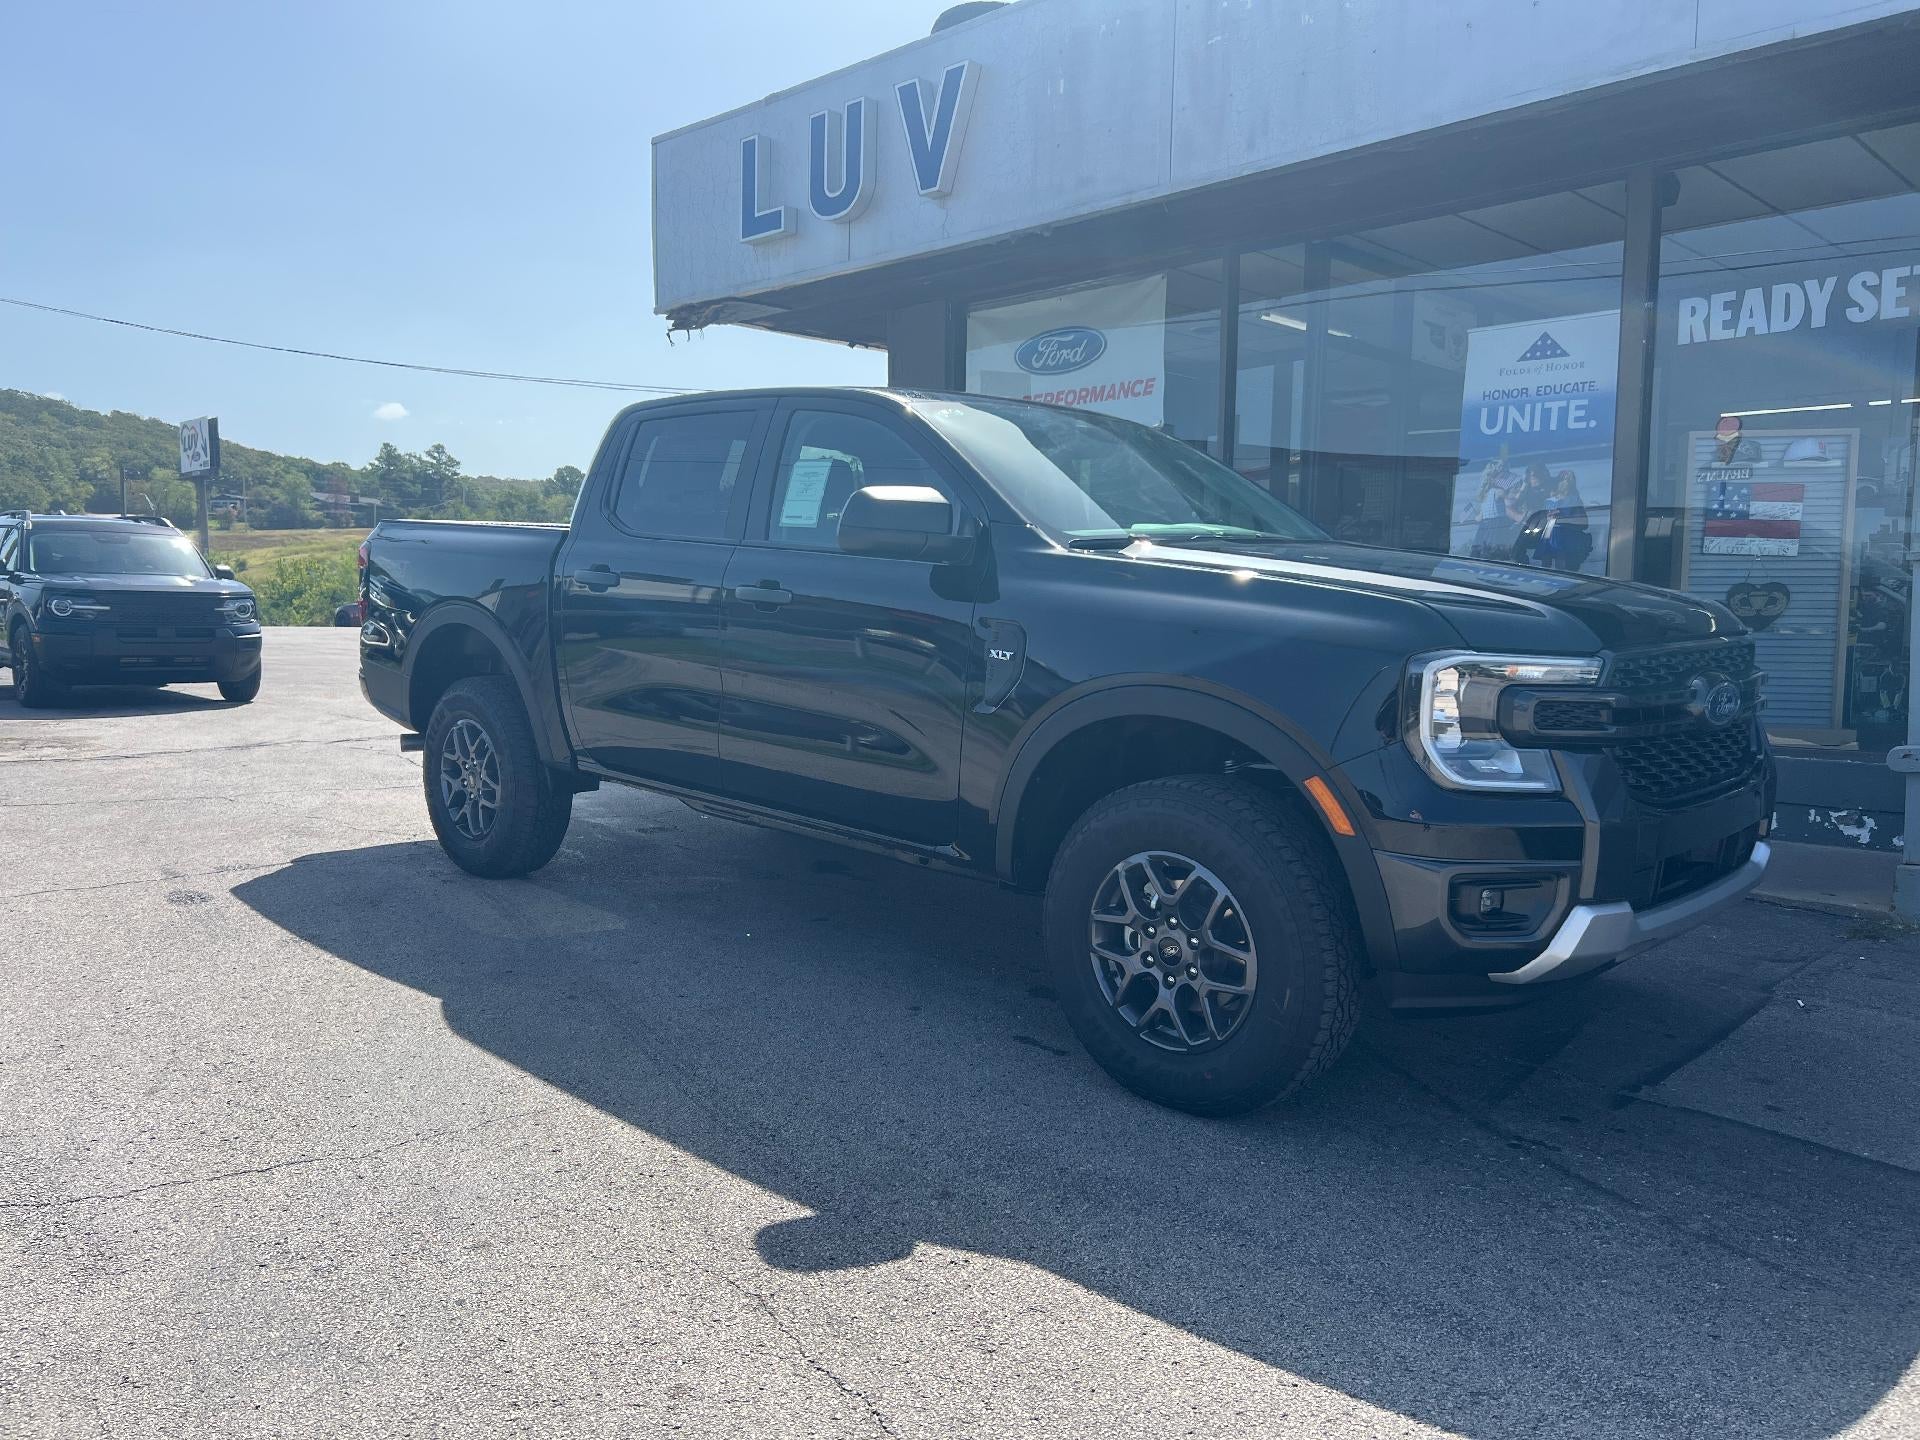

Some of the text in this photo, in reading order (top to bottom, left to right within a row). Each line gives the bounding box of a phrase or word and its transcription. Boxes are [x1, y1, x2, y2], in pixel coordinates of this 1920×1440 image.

[740, 60, 981, 244] LUV
[1677, 265, 1920, 345] READY SE
[1032, 335, 1088, 369] Ford
[1546, 361, 1585, 372] HONOR
[1482, 380, 1599, 401] HONOR. EDUCATE.
[1479, 399, 1598, 436] UNITE.
[989, 649, 1014, 661] XLT
